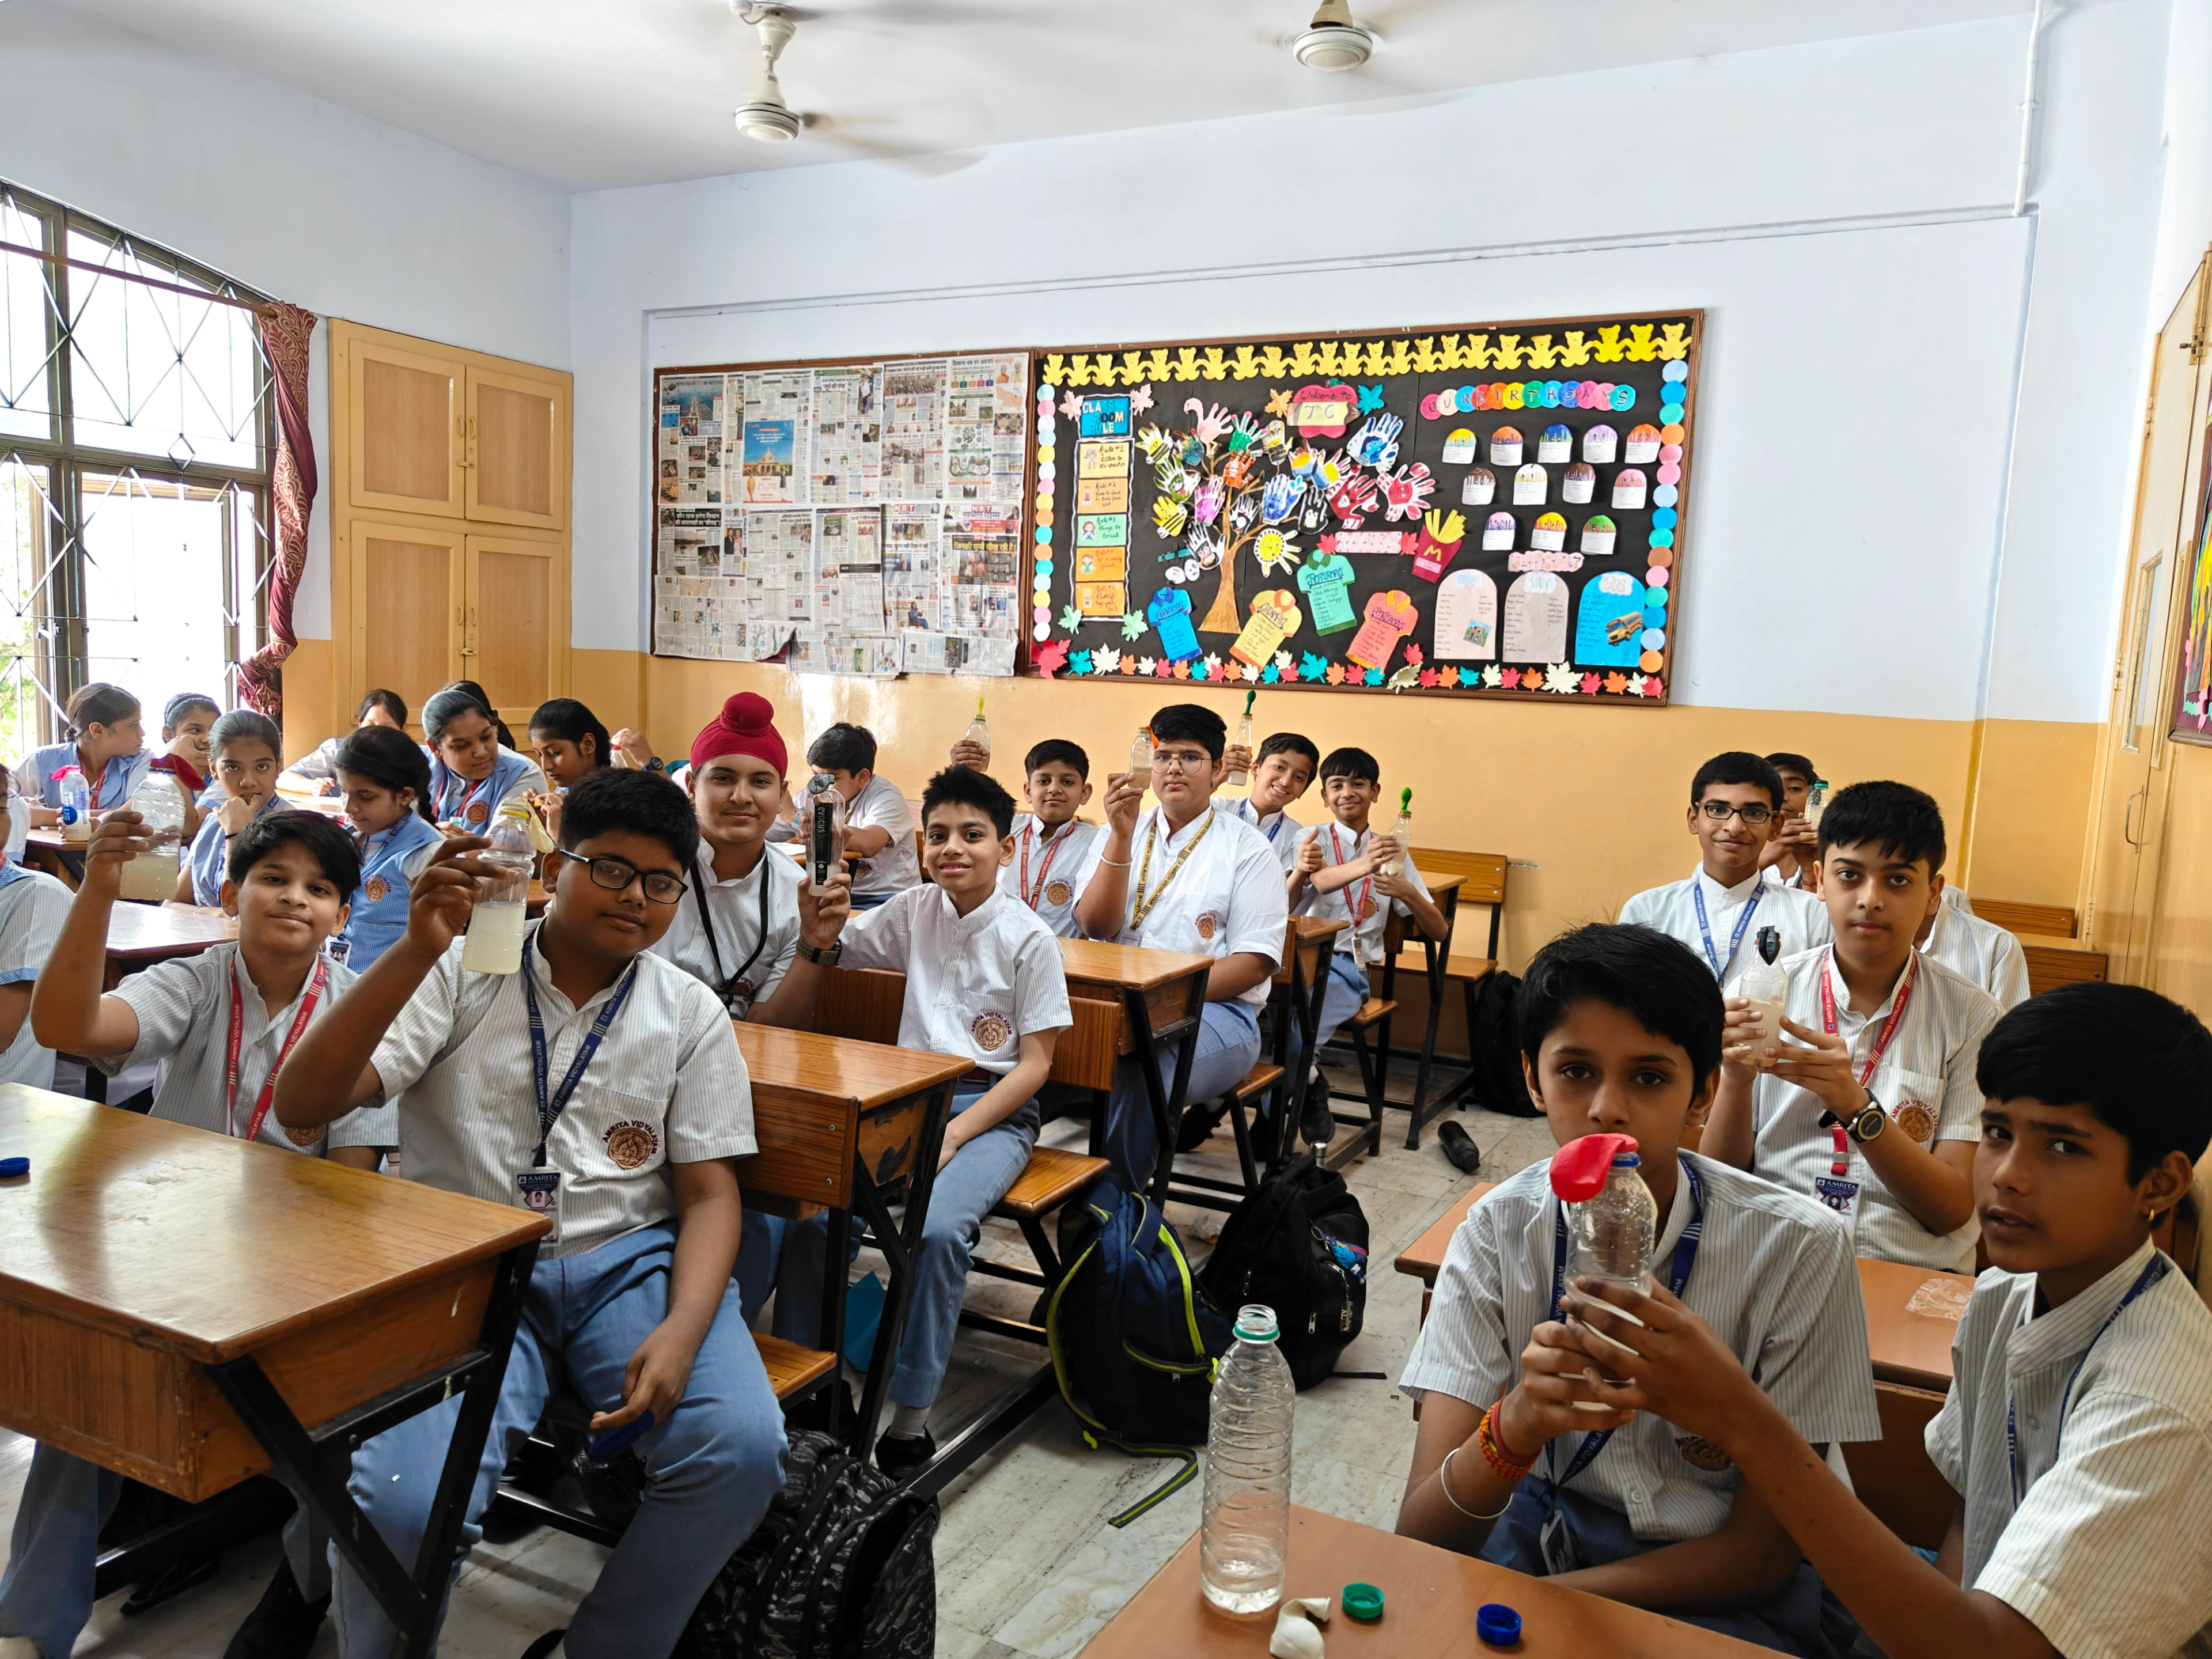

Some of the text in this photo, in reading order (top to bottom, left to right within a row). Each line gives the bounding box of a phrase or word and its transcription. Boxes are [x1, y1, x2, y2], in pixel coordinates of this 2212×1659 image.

[1082, 400, 1116, 414] CLASS
[1300, 391, 1351, 400] Welcome to
[1429, 388, 1628, 412] OUR BIRTHDAYS
[1325, 404, 1335, 419] C
[894, 504, 915, 512] NBT
[1603, 576, 1626, 592] BUS
[1040, 862, 1049, 878] AMRITA
[1142, 853, 1150, 881] VIDYALAYAM
[1150, 879, 1168, 906] VIDYALAYAM
[1737, 901, 1755, 933] AMRITA VIDYALAYAM
[605, 997, 618, 1015] AMRITA
[290, 1011, 308, 1044] VIDYALAYAM
[971, 1012, 1012, 1035] AMRITA VIDYALAYAM
[1880, 995, 1904, 1043] AMRITA VIDYALAYAM
[535, 1040, 544, 1077] VIDYALAYAM
[560, 1044, 591, 1099] AMRITA VIDYALAYAM
[1891, 1100, 1910, 1119] AMRITA
[602, 1120, 659, 1154] AMRITA VIDYALAYAM
[1826, 1181, 1855, 1190] AMRITA
